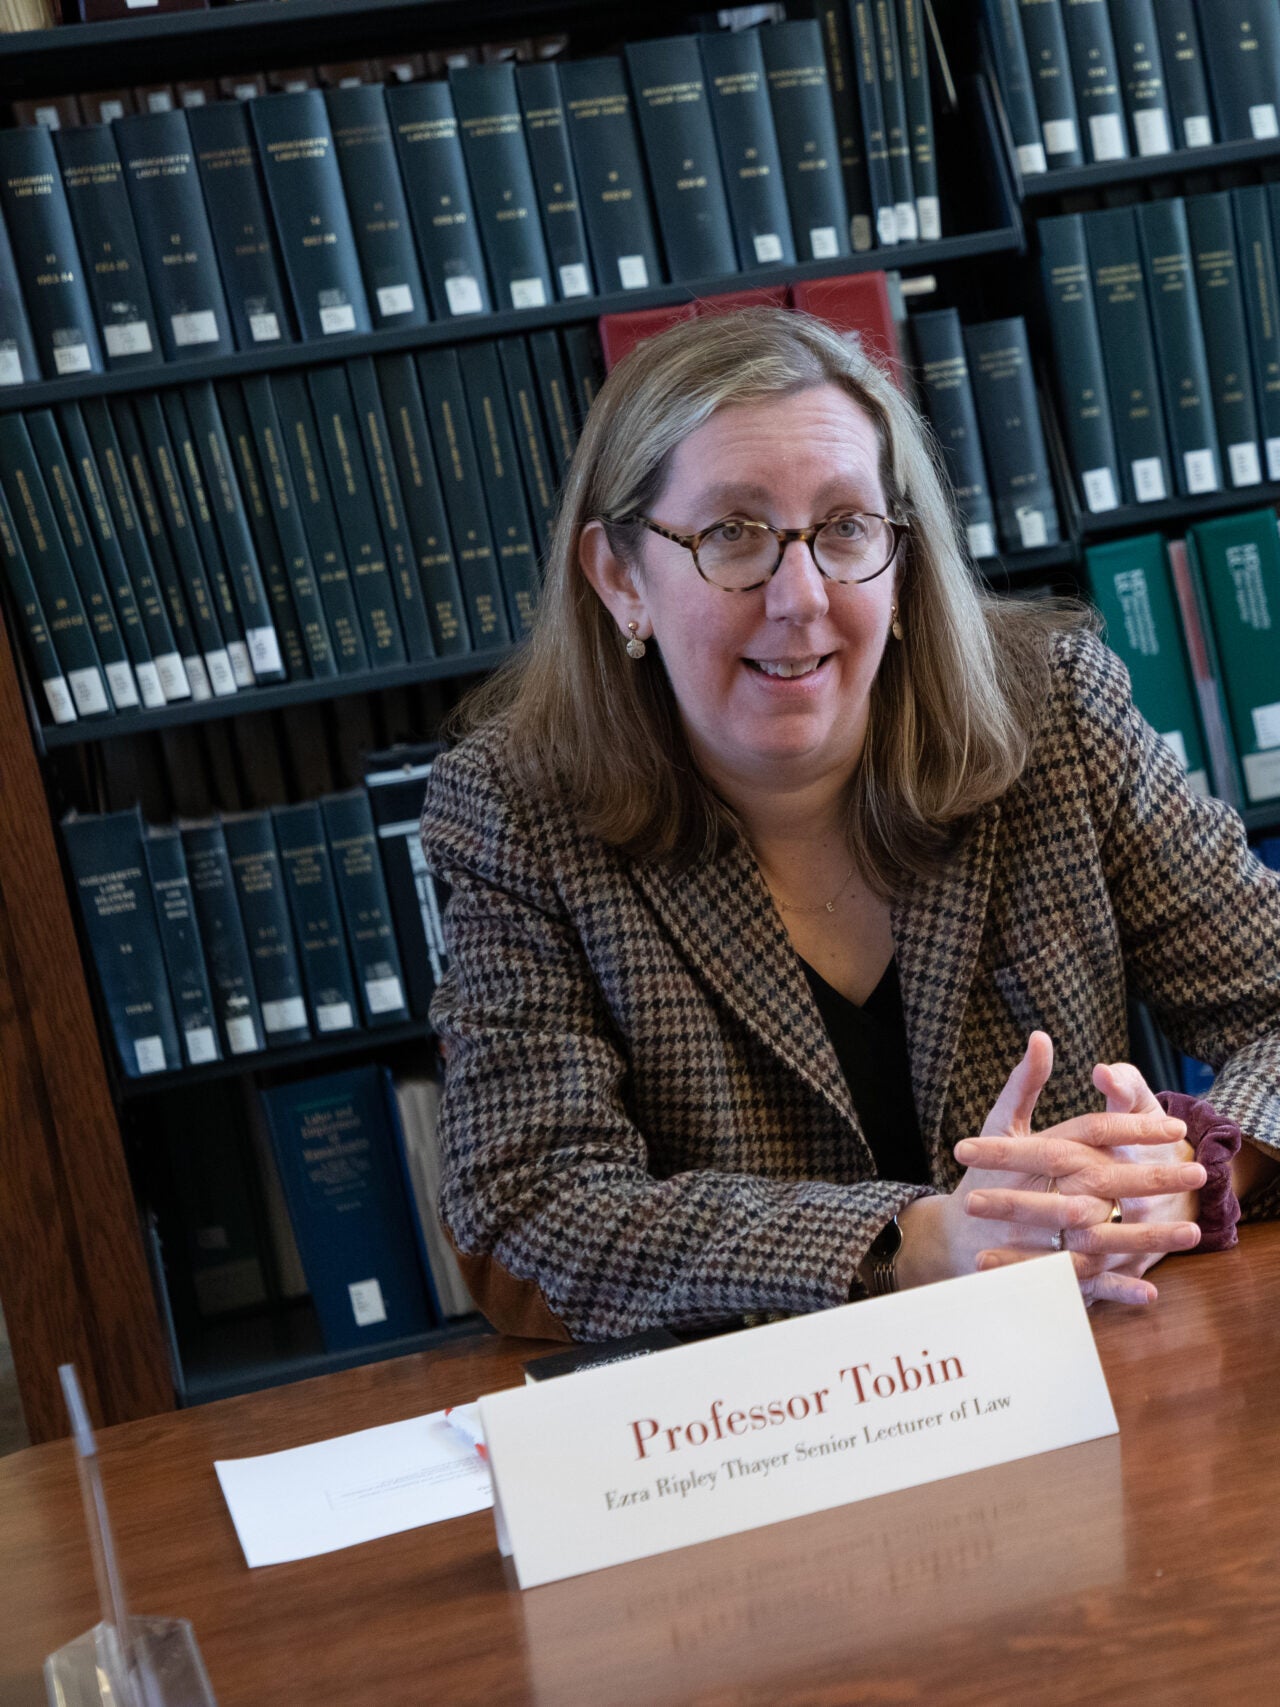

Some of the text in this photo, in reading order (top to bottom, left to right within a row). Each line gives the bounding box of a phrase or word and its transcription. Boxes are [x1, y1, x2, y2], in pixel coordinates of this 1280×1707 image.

[604, 1394, 1012, 1512] Ezra Ripley Thayer Senior Lecturer of Law
[628, 1349, 968, 1461] Professor Tobin
